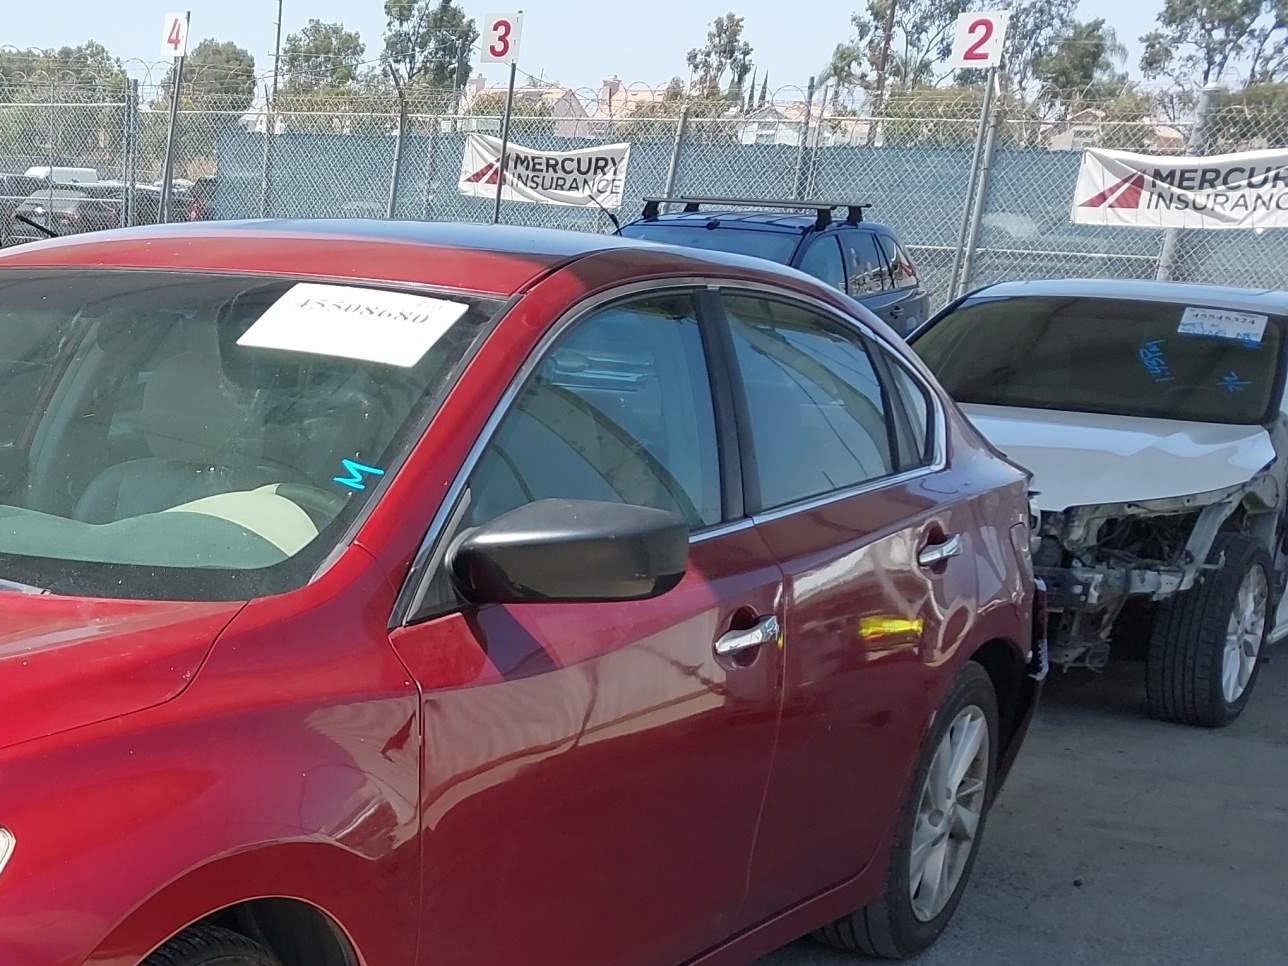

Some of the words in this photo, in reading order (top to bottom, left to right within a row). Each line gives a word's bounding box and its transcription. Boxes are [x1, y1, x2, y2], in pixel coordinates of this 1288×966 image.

[167, 18, 181, 51] 4
[489, 19, 512, 58] 3
[963, 18, 994, 61] 2
[513, 152, 625, 177] MERCURY
[510, 172, 623, 195] INSURANCE
[298, 298, 431, 325] 45508680
[333, 459, 384, 490] M
